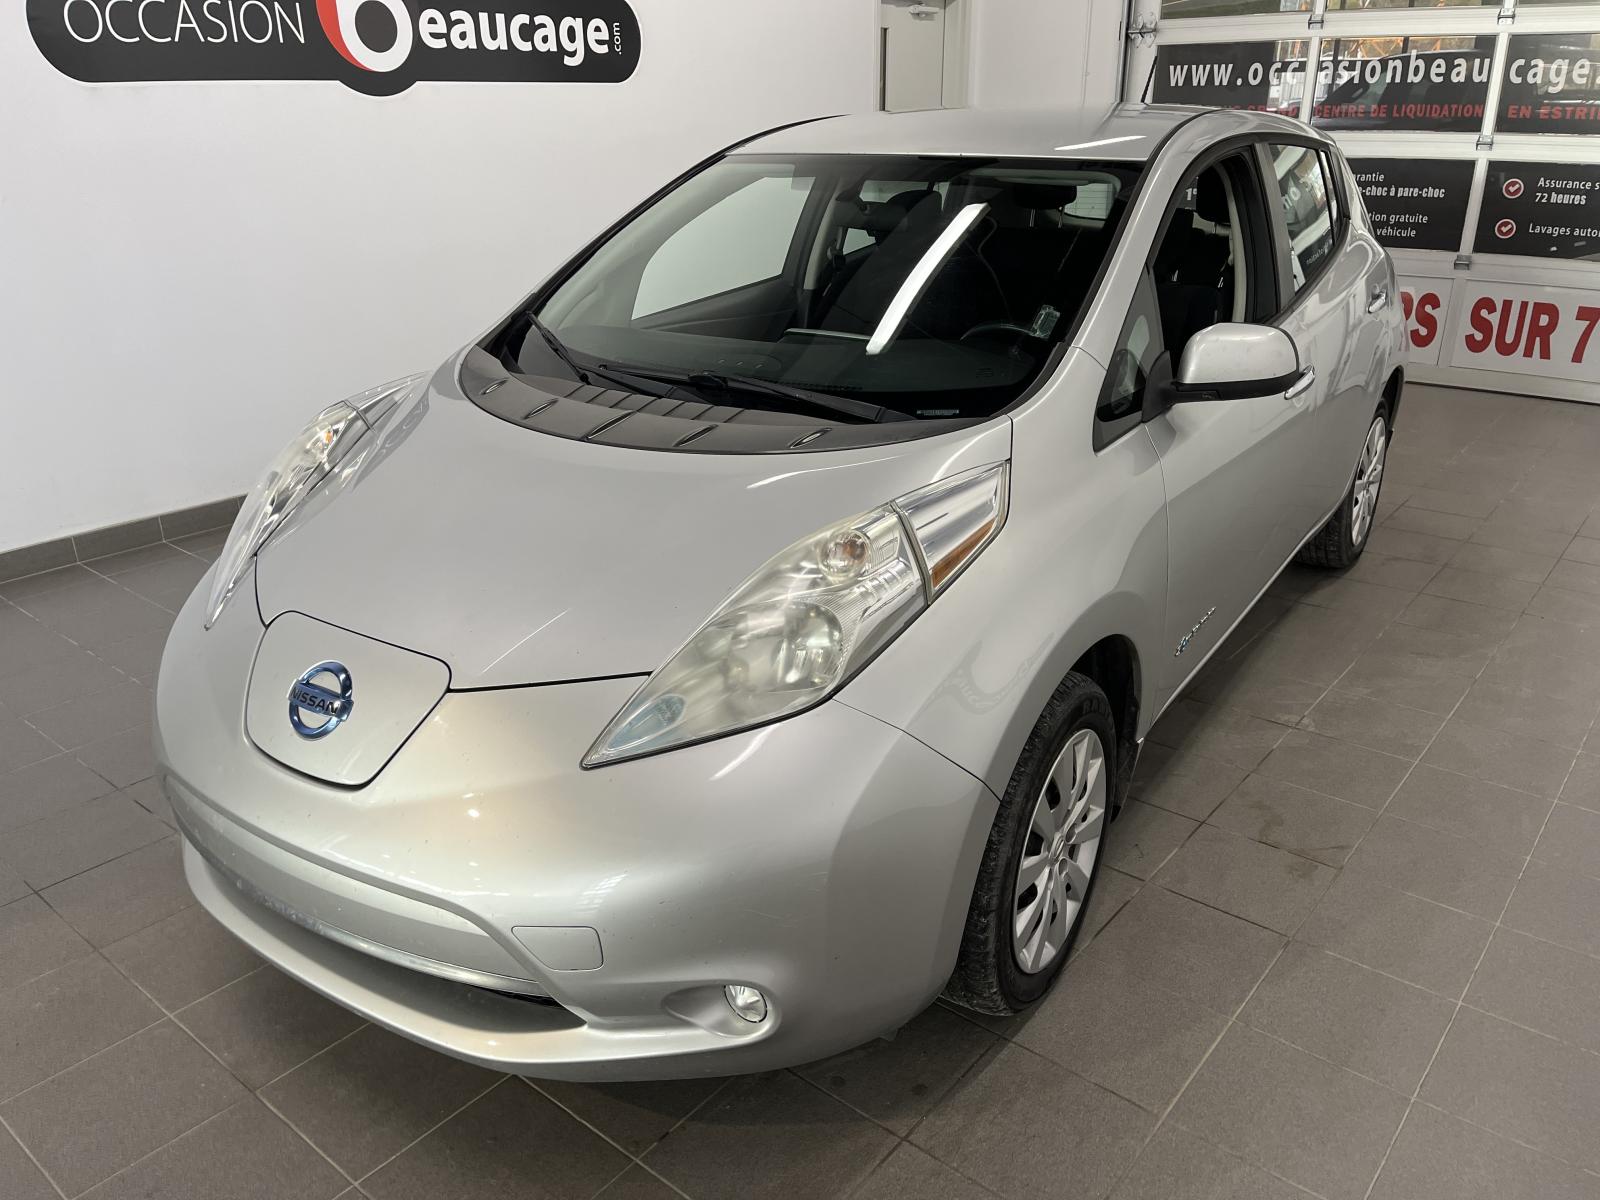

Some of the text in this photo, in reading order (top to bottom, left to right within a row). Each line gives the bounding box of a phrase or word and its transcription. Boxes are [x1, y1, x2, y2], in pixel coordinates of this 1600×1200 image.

[63, 0, 305, 44] OCCASION
[612, 22, 622, 55] .com
[1314, 104, 1366, 119] CENTRE
[1370, 105, 1388, 117] DE
[1393, 103, 1484, 118] LIQUIDATION
[1507, 105, 1533, 119] EN
[1537, 177, 1592, 190] Assurance
[1389, 184, 1395, 197] à
[1397, 186, 1445, 198] pare-choc
[1535, 191, 1587, 205] 72 heures
[1389, 213, 1428, 224] gratuite
[1376, 226, 1416, 237] véhicule
[1528, 223, 1600, 237] Lavages auto
[1465, 297, 1559, 361] SUR
[1571, 305, 1600, 364] 7
[290, 687, 338, 714] NISSAN
